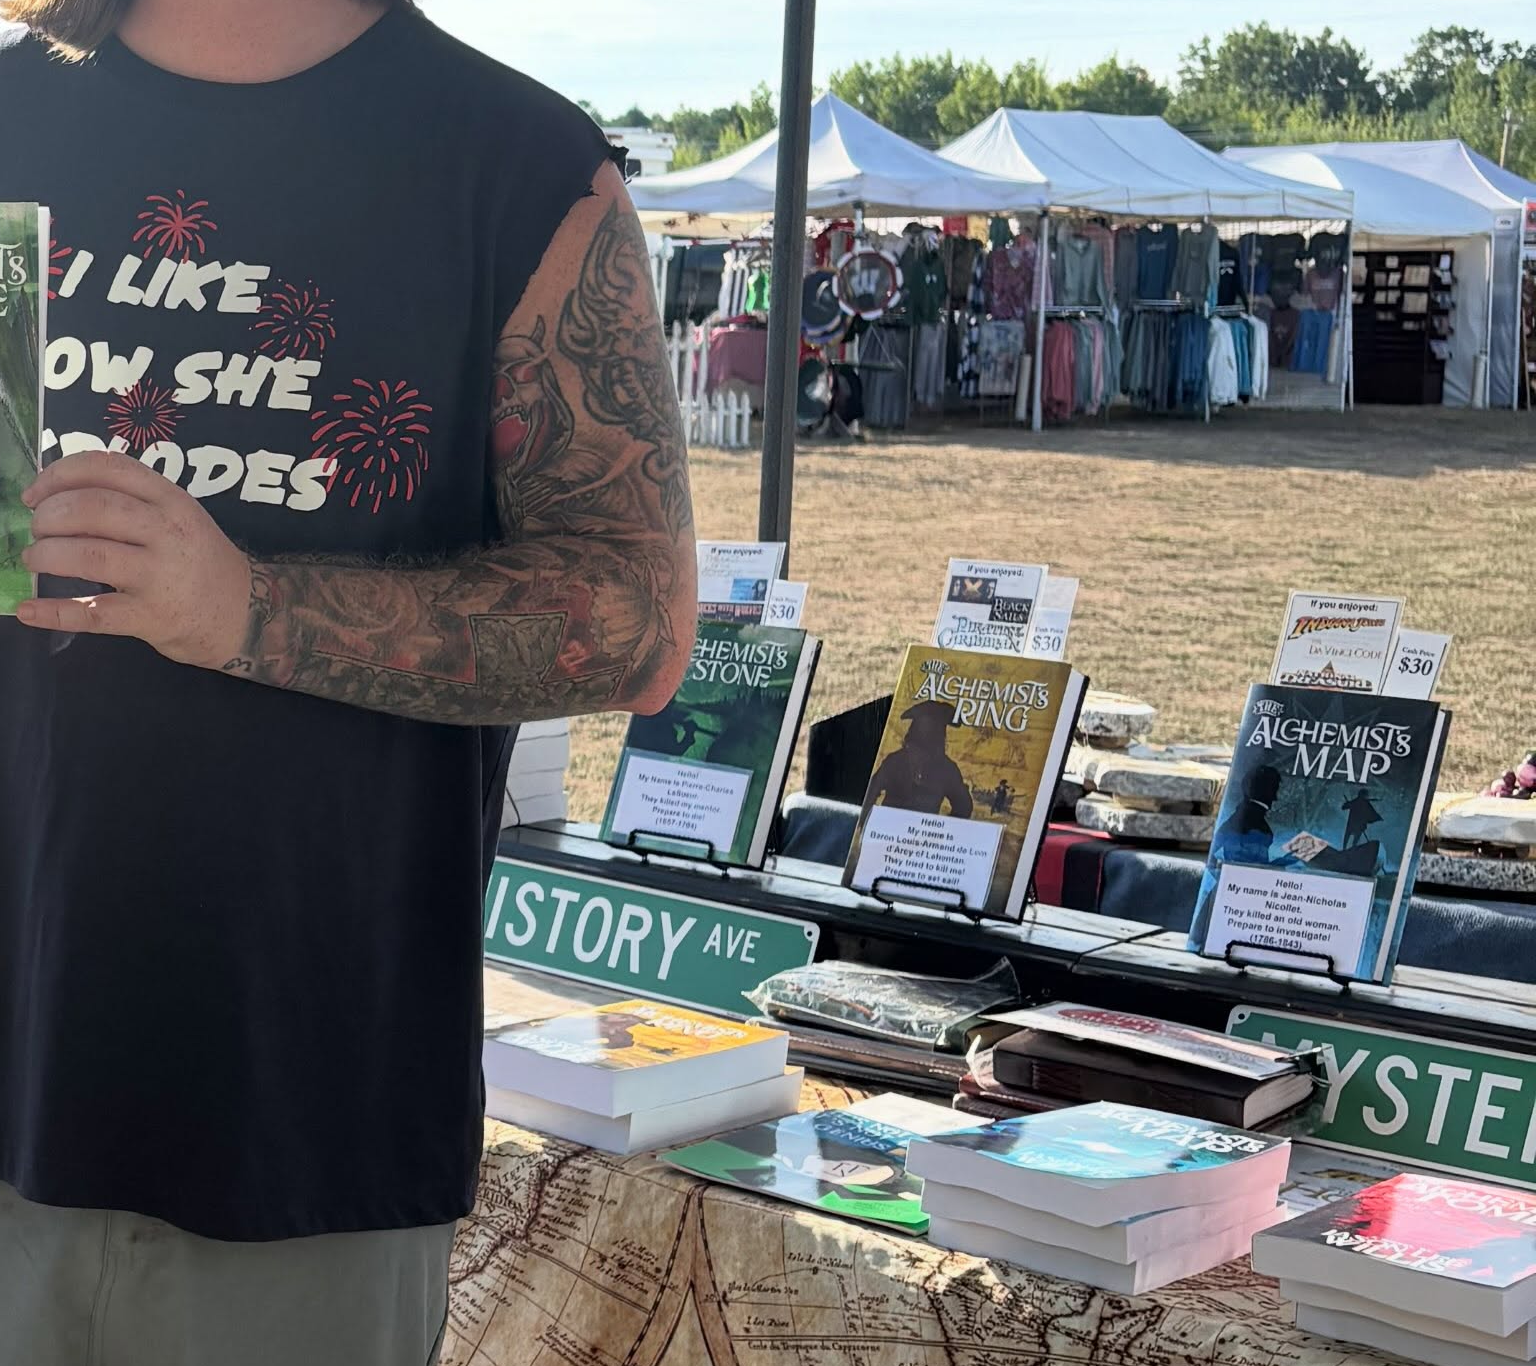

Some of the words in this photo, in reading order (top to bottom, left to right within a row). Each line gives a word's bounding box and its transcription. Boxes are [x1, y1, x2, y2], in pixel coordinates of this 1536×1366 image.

[59, 250, 94, 298] I
[107, 254, 270, 313] LIKE
[44, 336, 154, 396] OW
[171, 351, 321, 411] SHE
[718, 548, 732, 556] you
[967, 565, 973, 573] If
[975, 567, 989, 575] you
[769, 603, 795, 620] $30
[1311, 600, 1318, 608] If
[1320, 601, 1336, 610] you
[1339, 603, 1378, 612] enjoyed:
[1032, 635, 1061, 652] $30
[693, 658, 773, 688] STONE
[1398, 657, 1433, 676] $30
[915, 673, 1049, 710] ALCHEMIST'S
[952, 698, 1031, 732] RING
[1246, 716, 1411, 757] ALCHEMIST'S
[1292, 743, 1391, 783] MAP
[638, 773, 649, 781] My
[641, 793, 658, 804] They
[660, 797, 680, 808] killed
[681, 801, 692, 809] my
[652, 806, 680, 818] Prepare
[682, 810, 690, 818] to
[921, 818, 945, 828] Hello!
[870, 831, 894, 842] Baron
[896, 837, 955, 853] Louis-Armand
[907, 827, 920, 835] My
[922, 829, 944, 839] name
[884, 855, 903, 867] They
[905, 858, 924, 870] tried
[926, 862, 934, 871] to
[936, 863, 948, 873] kill
[950, 866, 965, 875] me!
[885, 866, 915, 879] Prepare
[917, 871, 926, 880] to
[927, 873, 940, 882] set
[1276, 879, 1303, 891] Hello!
[1227, 884, 1241, 894] My
[1243, 887, 1268, 897] name
[1270, 890, 1279, 898] is
[1280, 891, 1347, 909] Jean-Nicholas
[1265, 901, 1302, 914] Nicollet.
[484, 874, 697, 980] ISTORY
[702, 923, 762, 964] AVE
[1224, 906, 1244, 918] They
[1247, 909, 1271, 921] killed
[1274, 914, 1285, 922] an
[1288, 915, 1302, 926] old
[1305, 920, 1341, 932] woman.
[1227, 918, 1263, 932] Prepare
[1265, 924, 1274, 932] to
[1276, 925, 1331, 942] investigate!
[1250, 934, 1302, 950] (1786-1843)
[1261, 1031, 1536, 1165] YSTE
